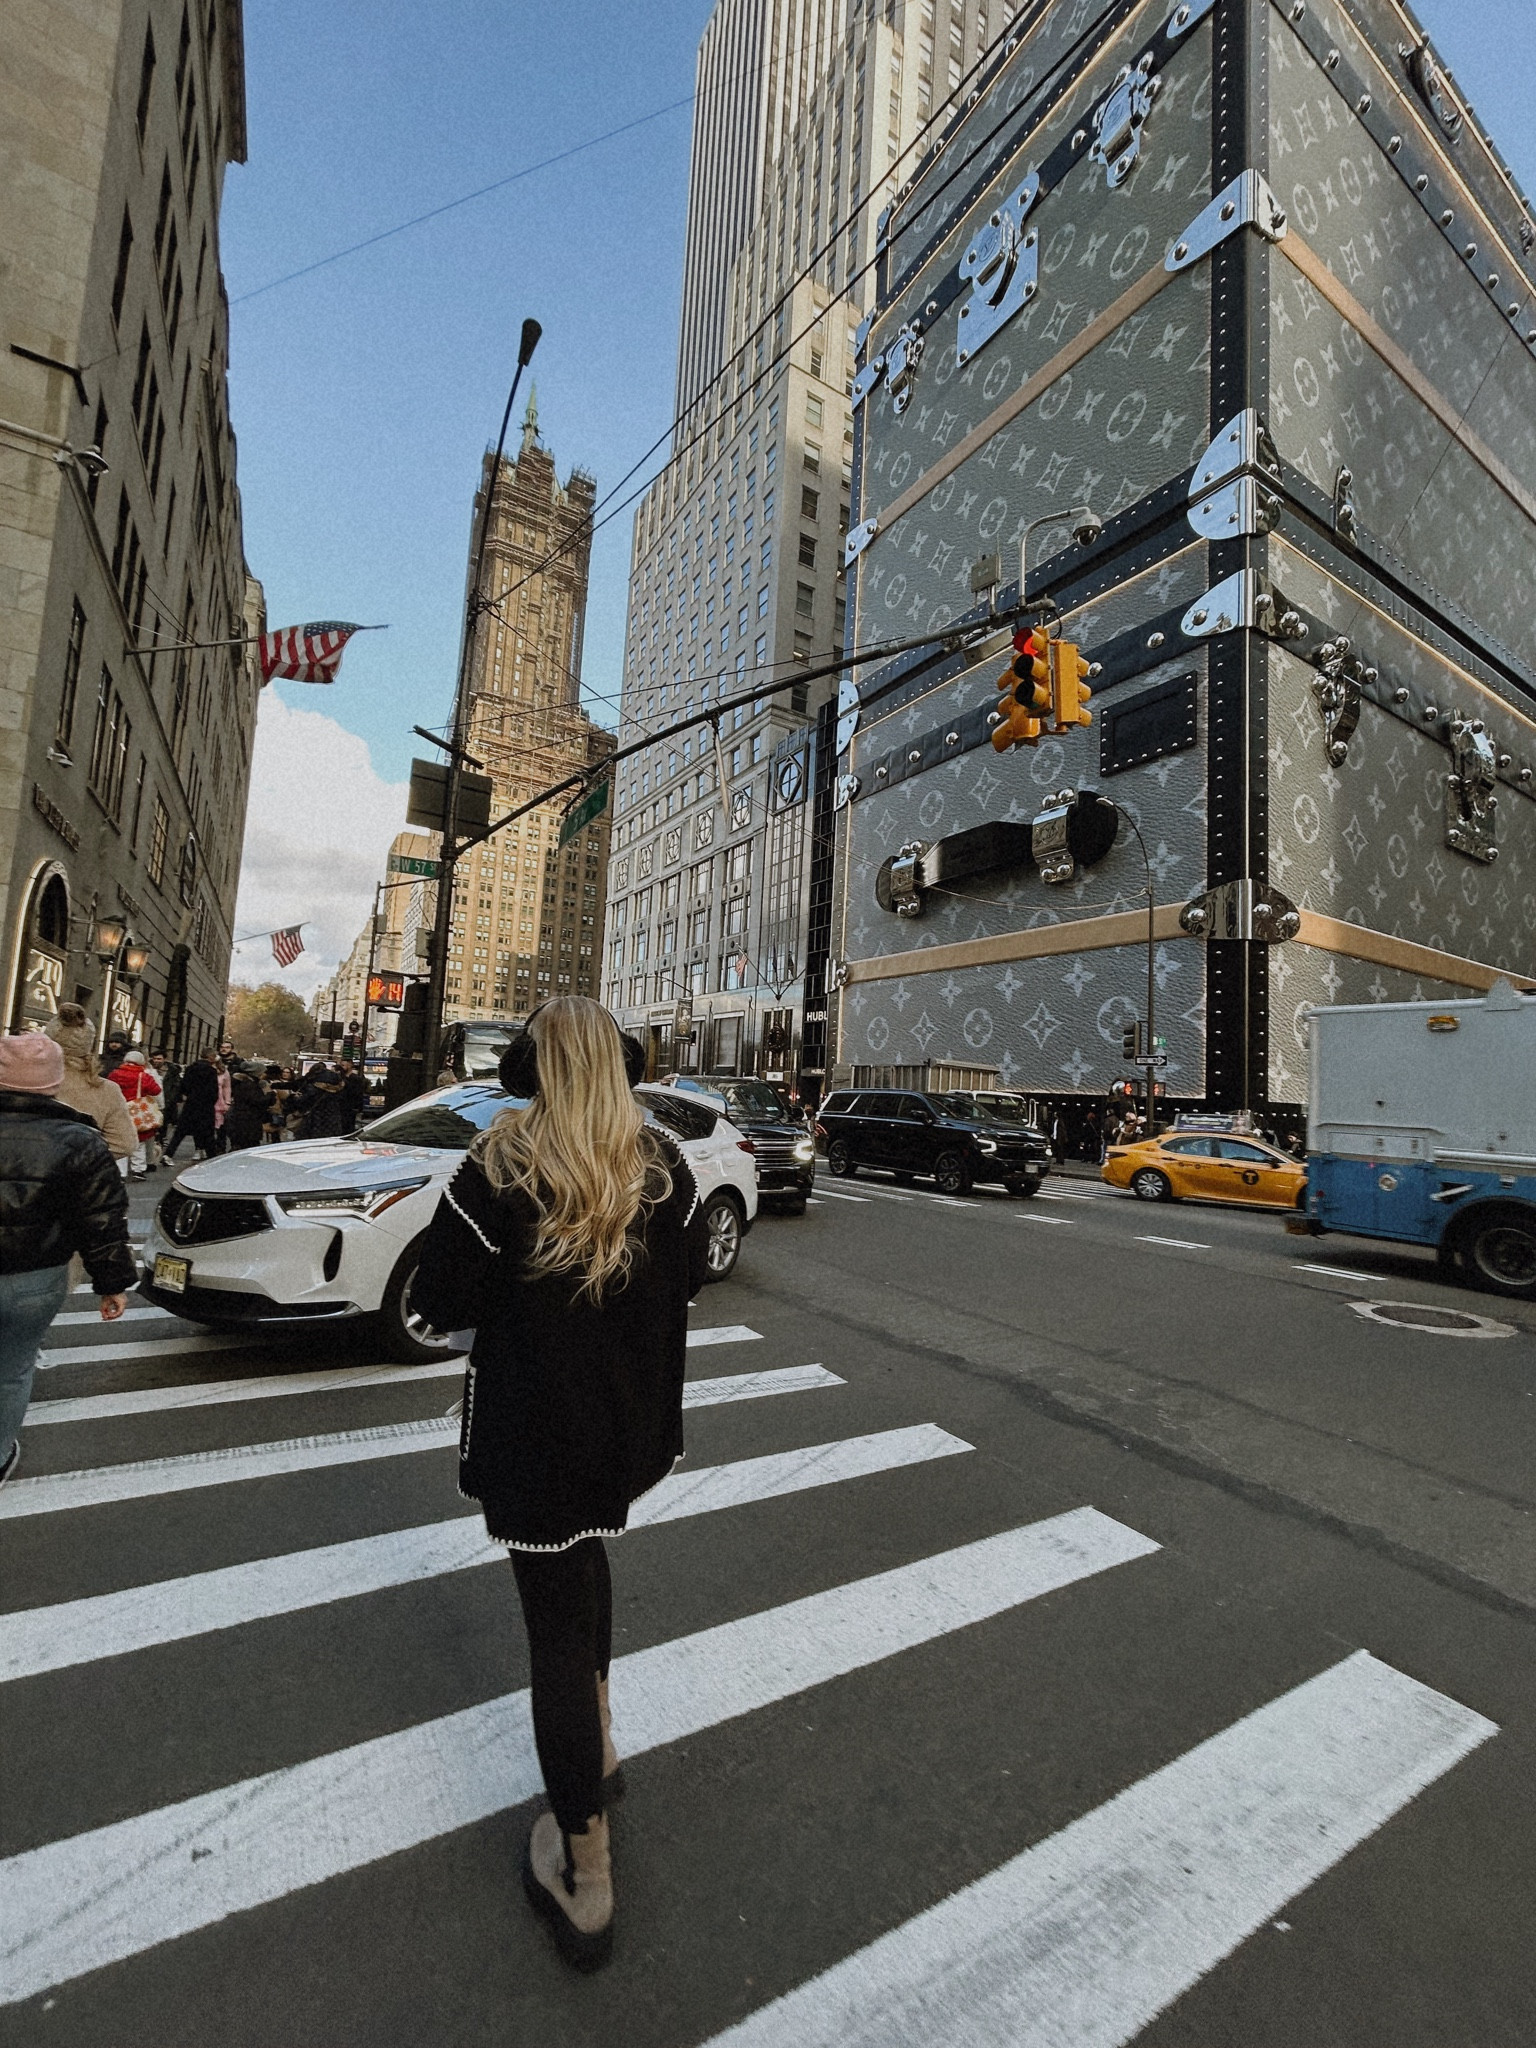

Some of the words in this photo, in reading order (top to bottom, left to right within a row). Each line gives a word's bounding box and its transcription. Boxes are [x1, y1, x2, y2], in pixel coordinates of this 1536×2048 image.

[401, 859, 411, 871] W
[415, 860, 426, 874] 57
[388, 982, 402, 1002] 14
